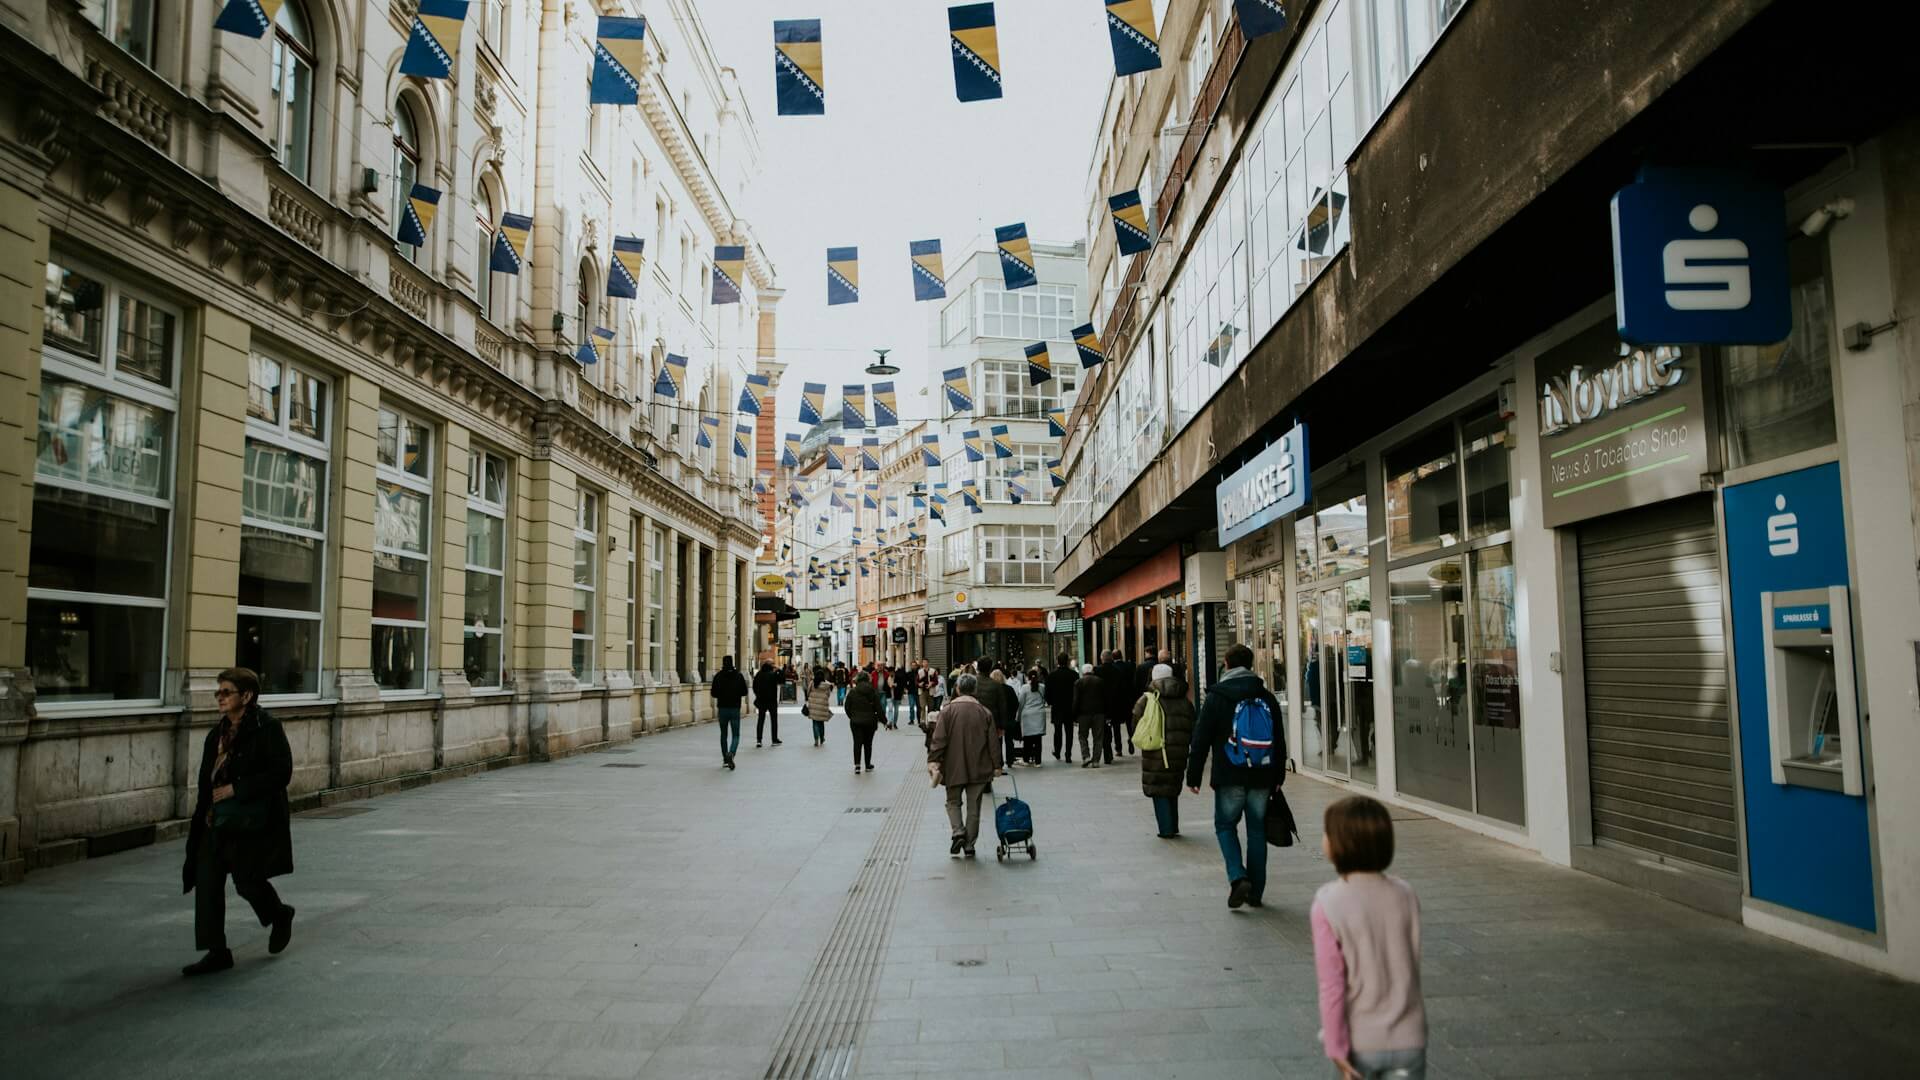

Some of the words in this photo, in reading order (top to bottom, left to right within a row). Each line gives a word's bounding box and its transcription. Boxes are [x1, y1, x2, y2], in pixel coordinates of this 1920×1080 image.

[1540, 342, 1684, 436] Novine
[1551, 461, 1580, 484] News
[1583, 453, 1591, 474] &
[1594, 439, 1648, 471] Tobacco
[1651, 425, 1688, 453] Shop
